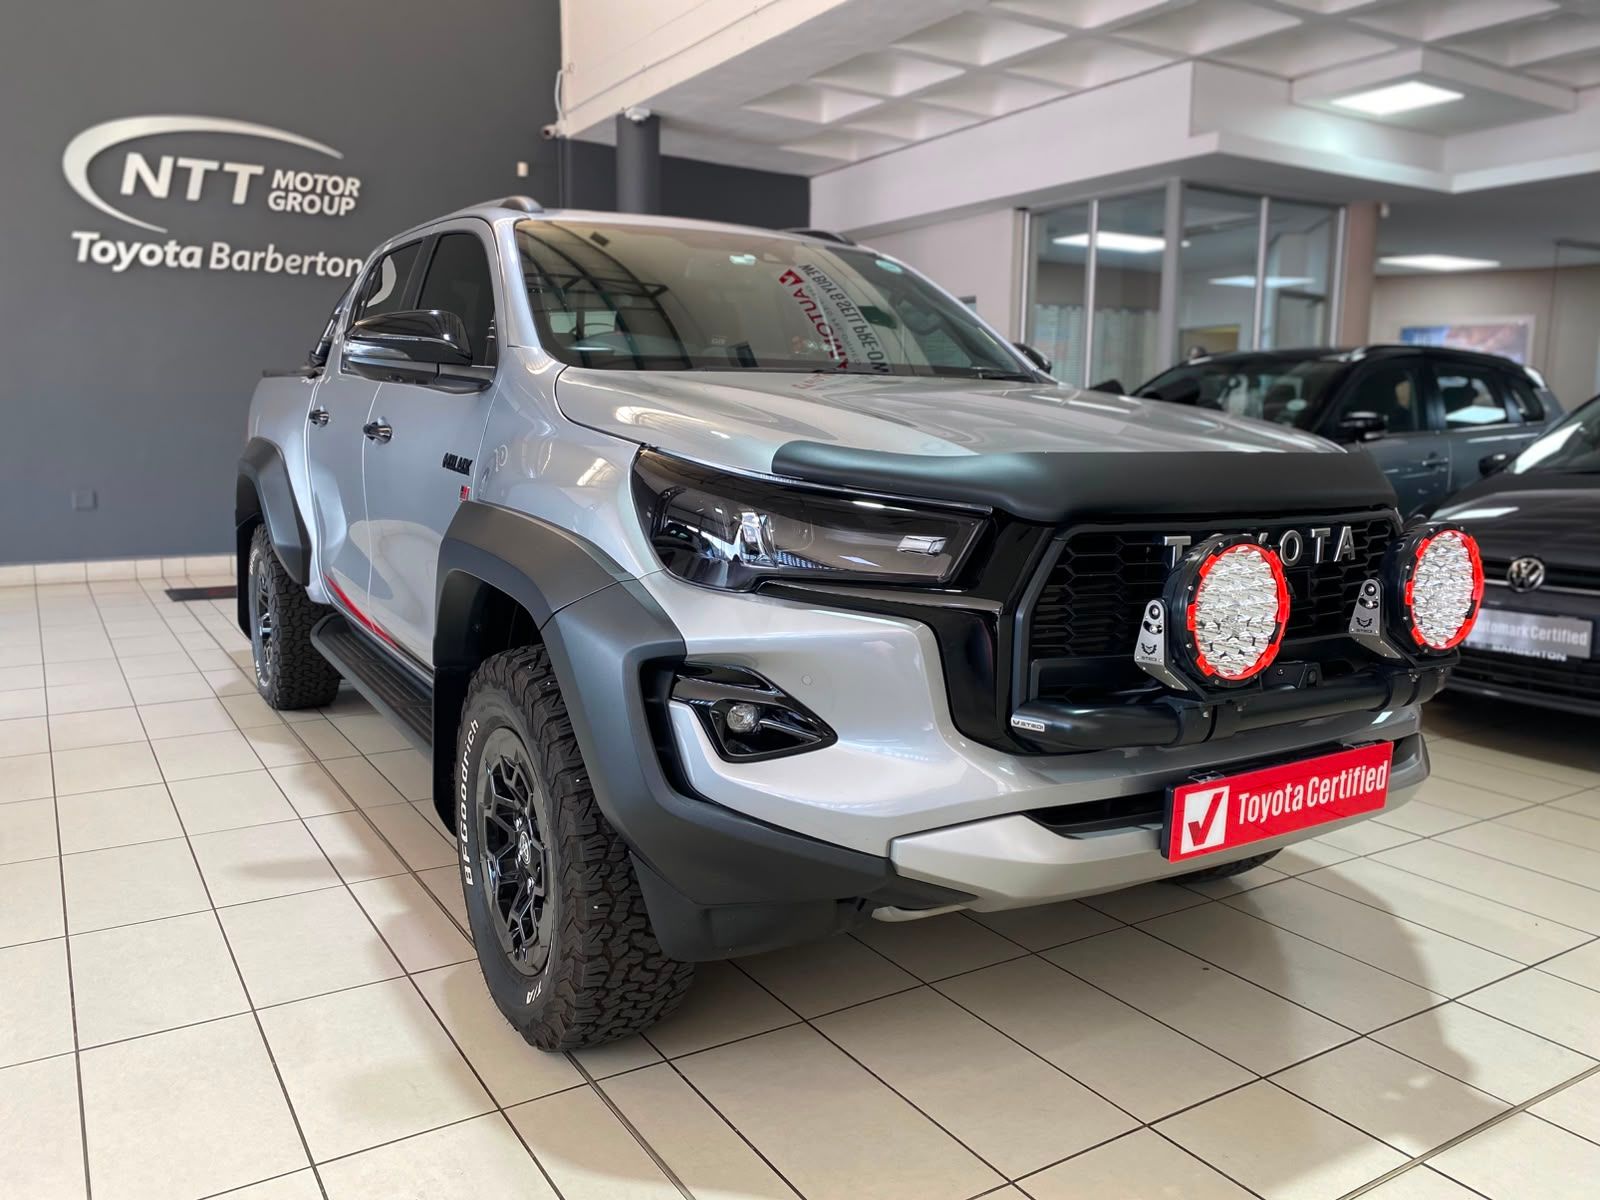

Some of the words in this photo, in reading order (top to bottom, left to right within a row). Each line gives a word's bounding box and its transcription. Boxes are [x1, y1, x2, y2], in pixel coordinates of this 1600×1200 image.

[120, 152, 265, 205] NTT
[271, 169, 361, 197] MOTOR
[267, 190, 356, 216] GROUP
[71, 231, 203, 272] Toyota
[208, 241, 364, 278] Barberton
[1163, 525, 1357, 569] TOTA
[460, 718, 479, 886] BFGoodrich
[1238, 782, 1304, 825] Toyota
[1306, 760, 1389, 808] Certified
